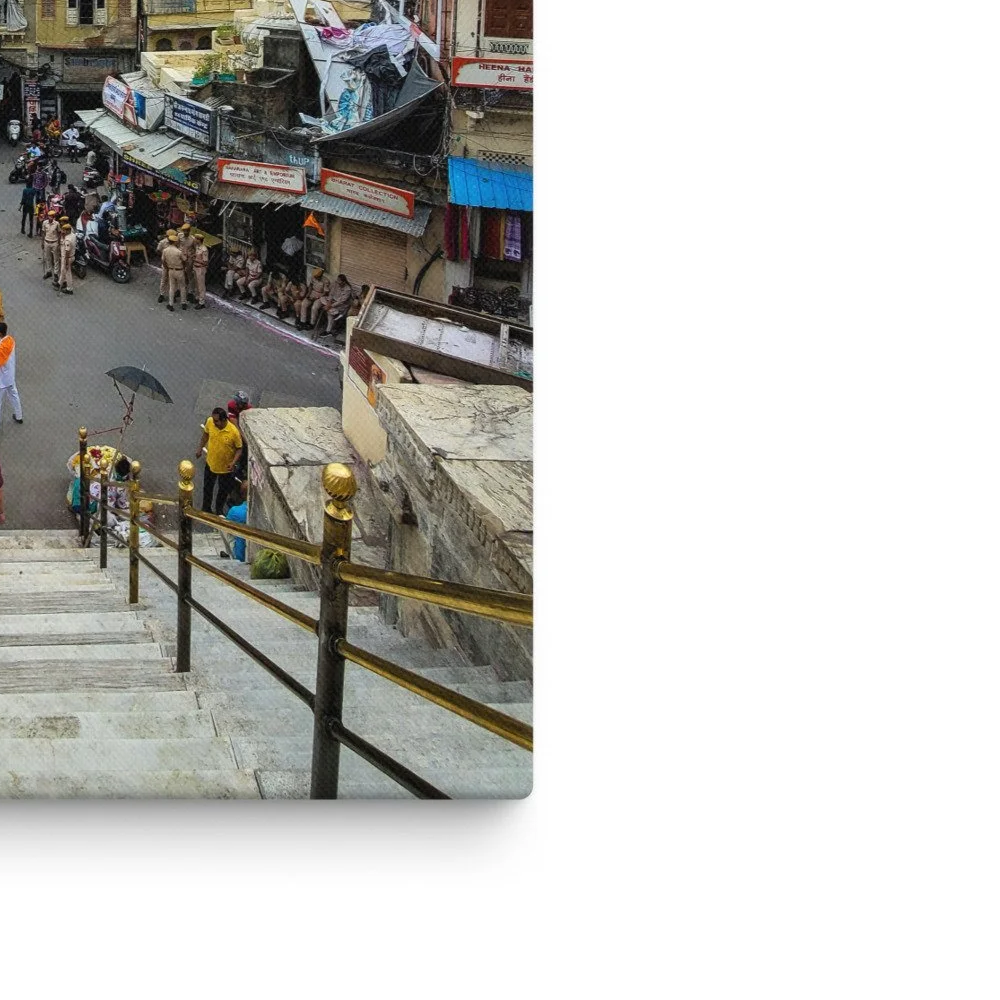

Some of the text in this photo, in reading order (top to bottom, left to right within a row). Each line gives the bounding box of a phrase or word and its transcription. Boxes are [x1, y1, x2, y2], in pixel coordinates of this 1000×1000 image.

[479, 63, 511, 72] HEENA
[330, 178, 399, 200] BHARAT COLLECTION
